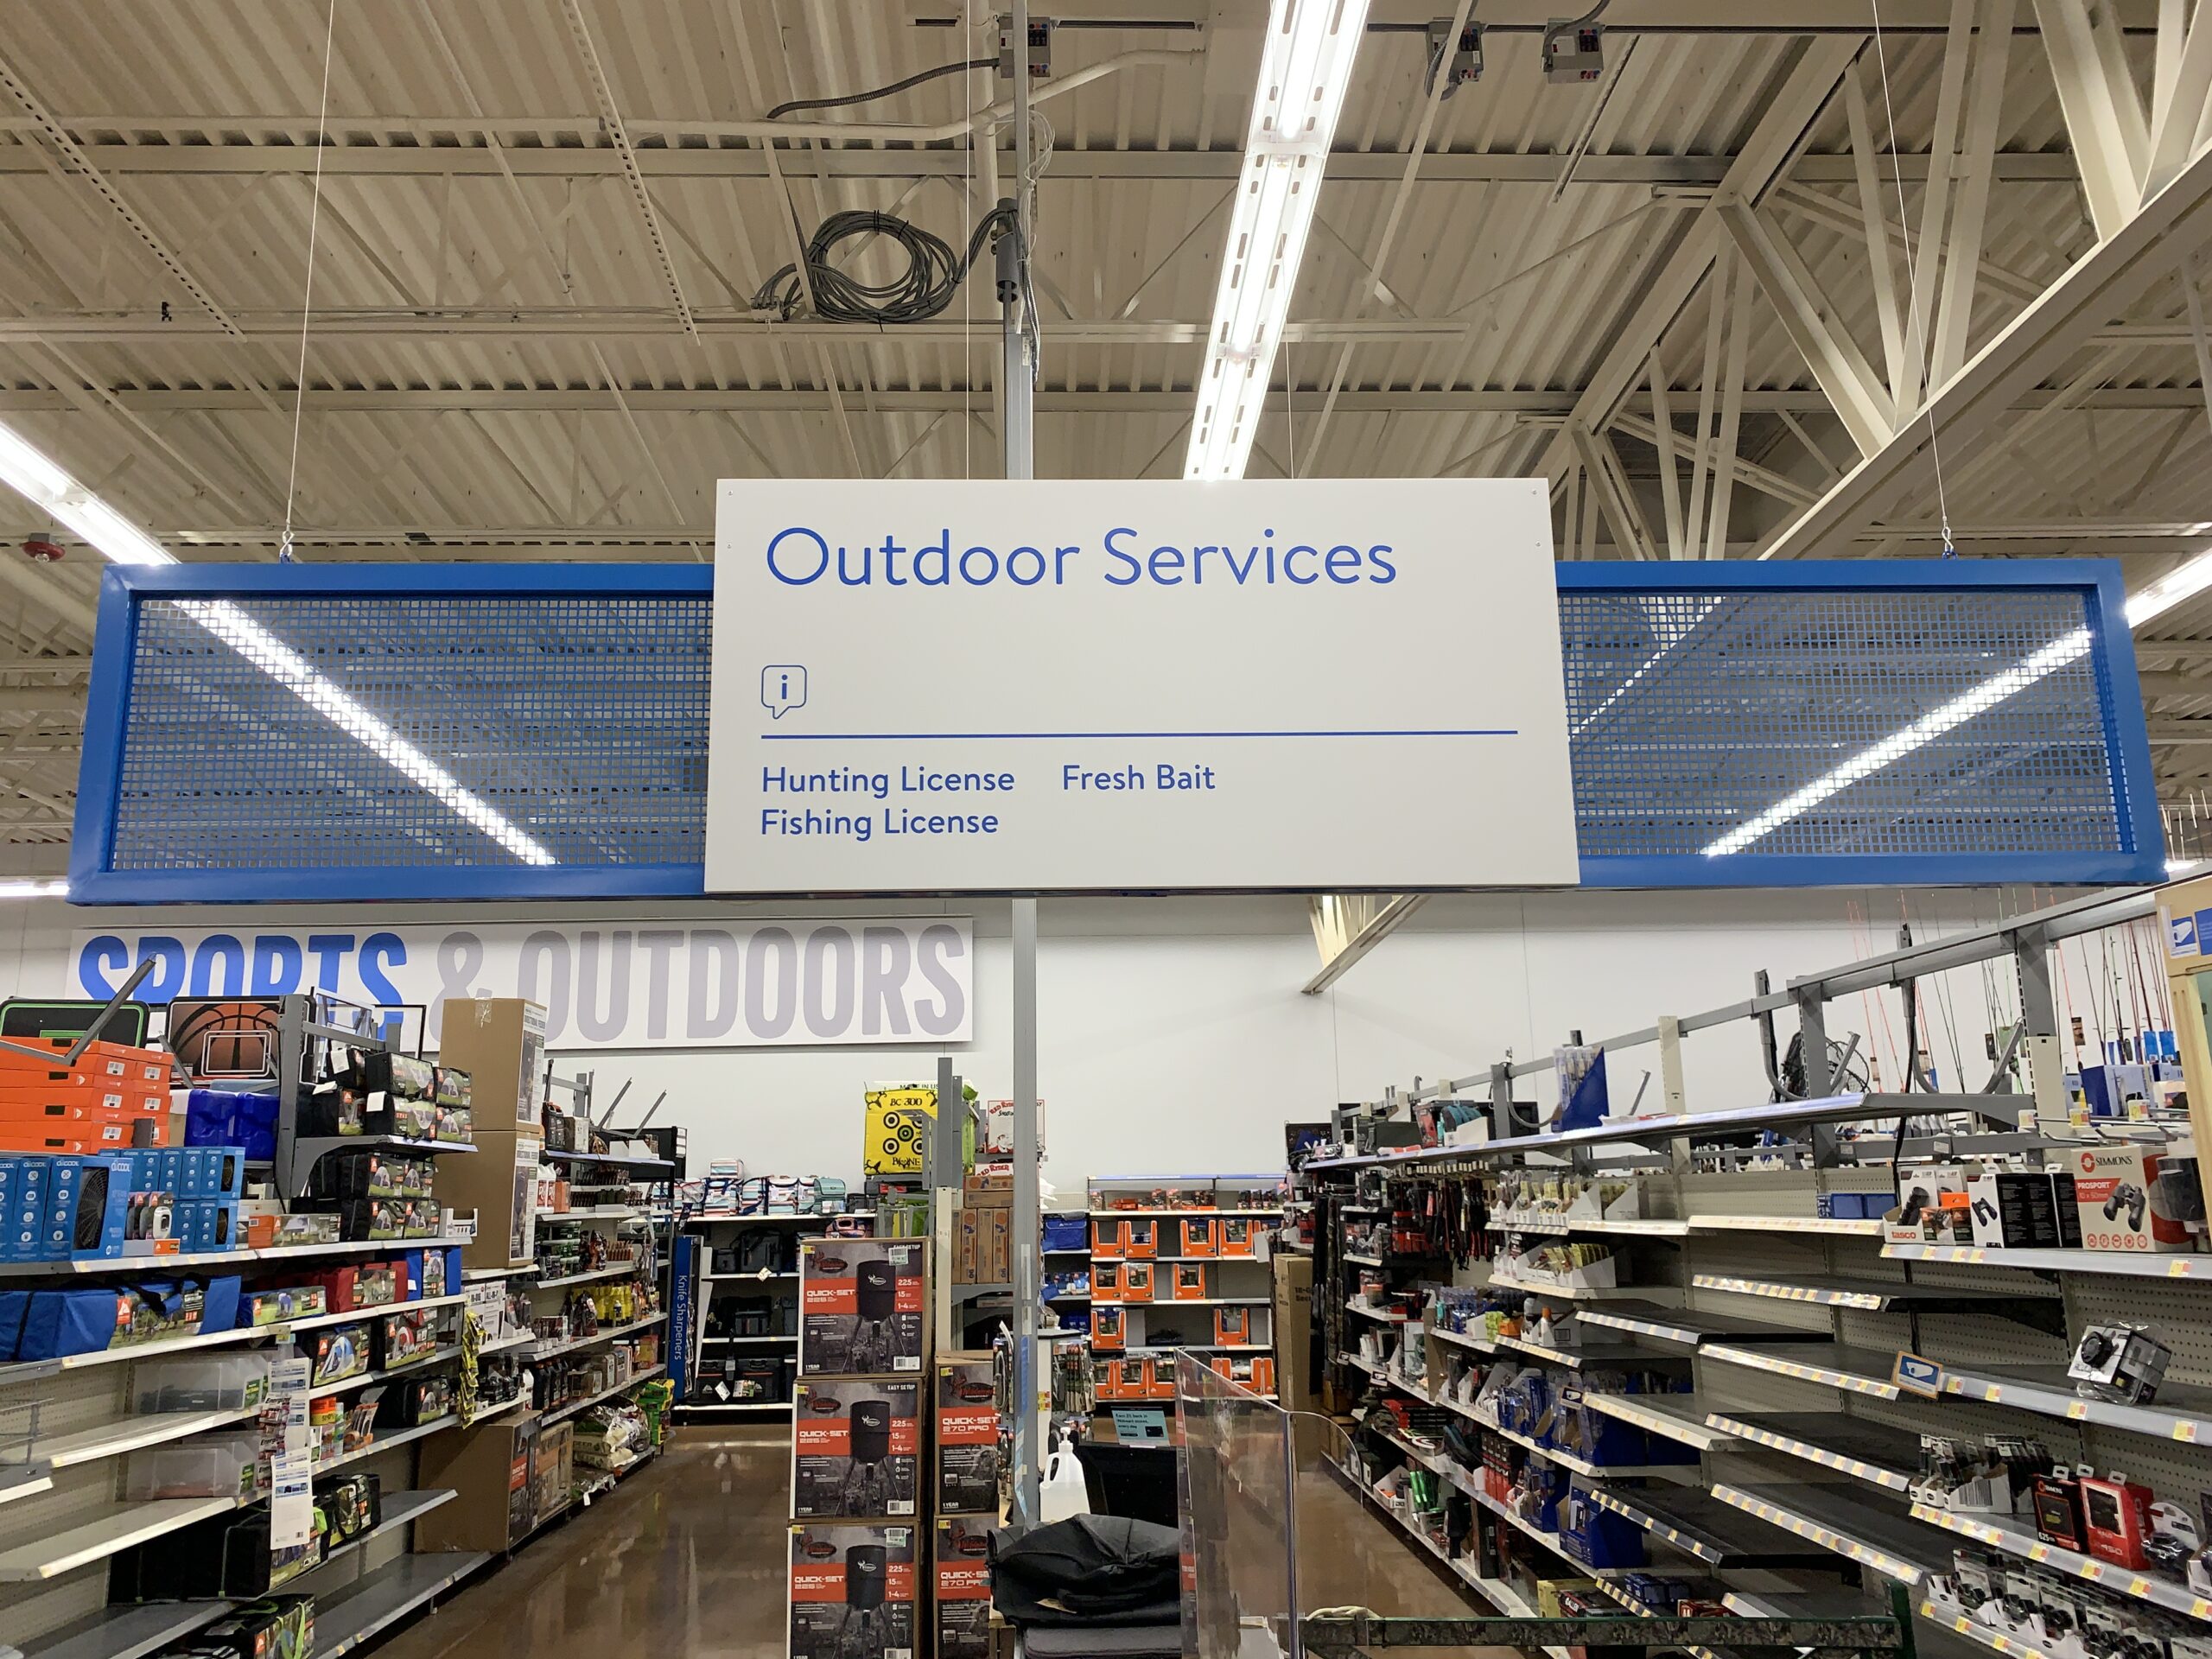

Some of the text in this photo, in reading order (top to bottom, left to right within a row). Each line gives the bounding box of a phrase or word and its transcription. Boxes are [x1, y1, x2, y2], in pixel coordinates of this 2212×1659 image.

[767, 528, 1397, 587] Outdoor Services
[763, 764, 1215, 798] Hunting License Fresh Bait
[762, 809, 998, 842] Fishing License
[79, 925, 964, 1043] SPORTS & OUTDOORS
[890, 1097, 923, 1107] BC 300
[2095, 1156, 2133, 1166] SIMMONS
[2077, 1181, 2111, 1190] PROSPORT
[674, 1275, 688, 1360] Knife Sharpeners
[942, 1417, 998, 1426] QUICK-SET
[2038, 1532, 2050, 1542] 625
[940, 1571, 989, 1580] QUICK-SE
